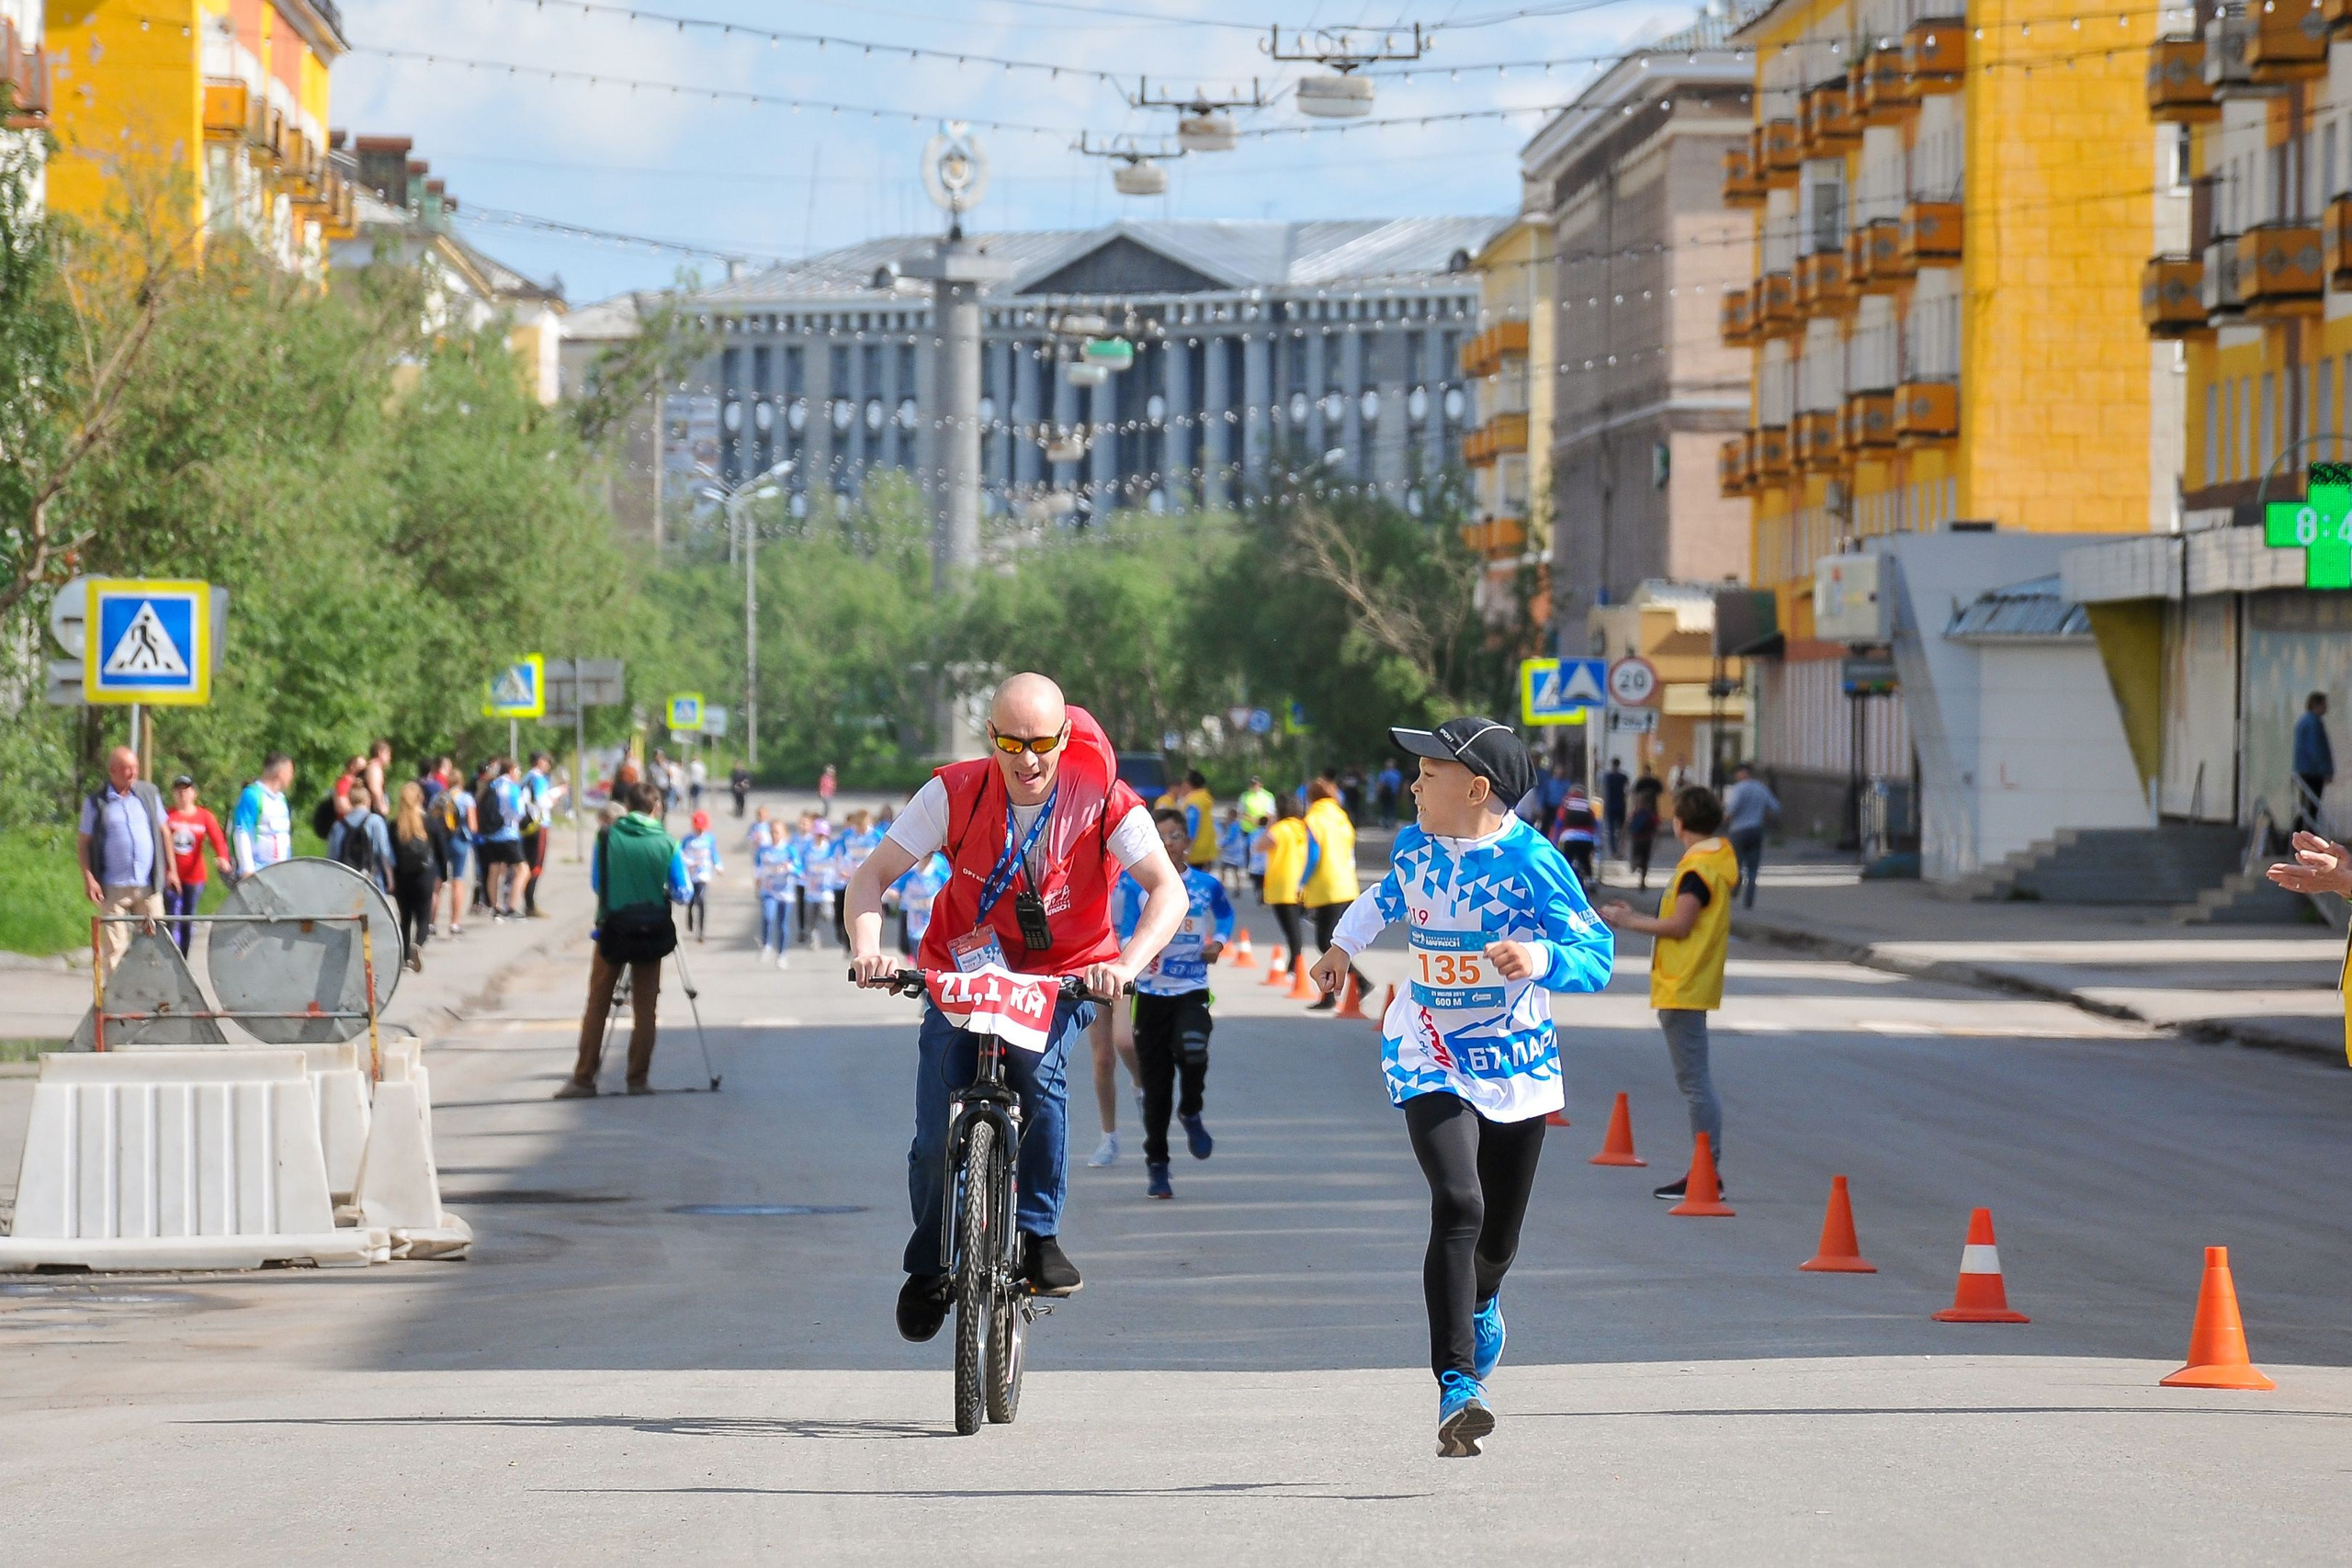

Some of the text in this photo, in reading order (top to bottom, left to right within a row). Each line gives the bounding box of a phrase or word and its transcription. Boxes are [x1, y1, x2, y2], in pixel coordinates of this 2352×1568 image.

[1619, 670, 1645, 690] 20
[1418, 953, 1481, 985] 135
[937, 974, 1046, 1019] 21,1 КМ
[1435, 998, 1452, 1007] 600
[1453, 998, 1463, 1006] М
[1468, 1044, 1501, 1071] 67
